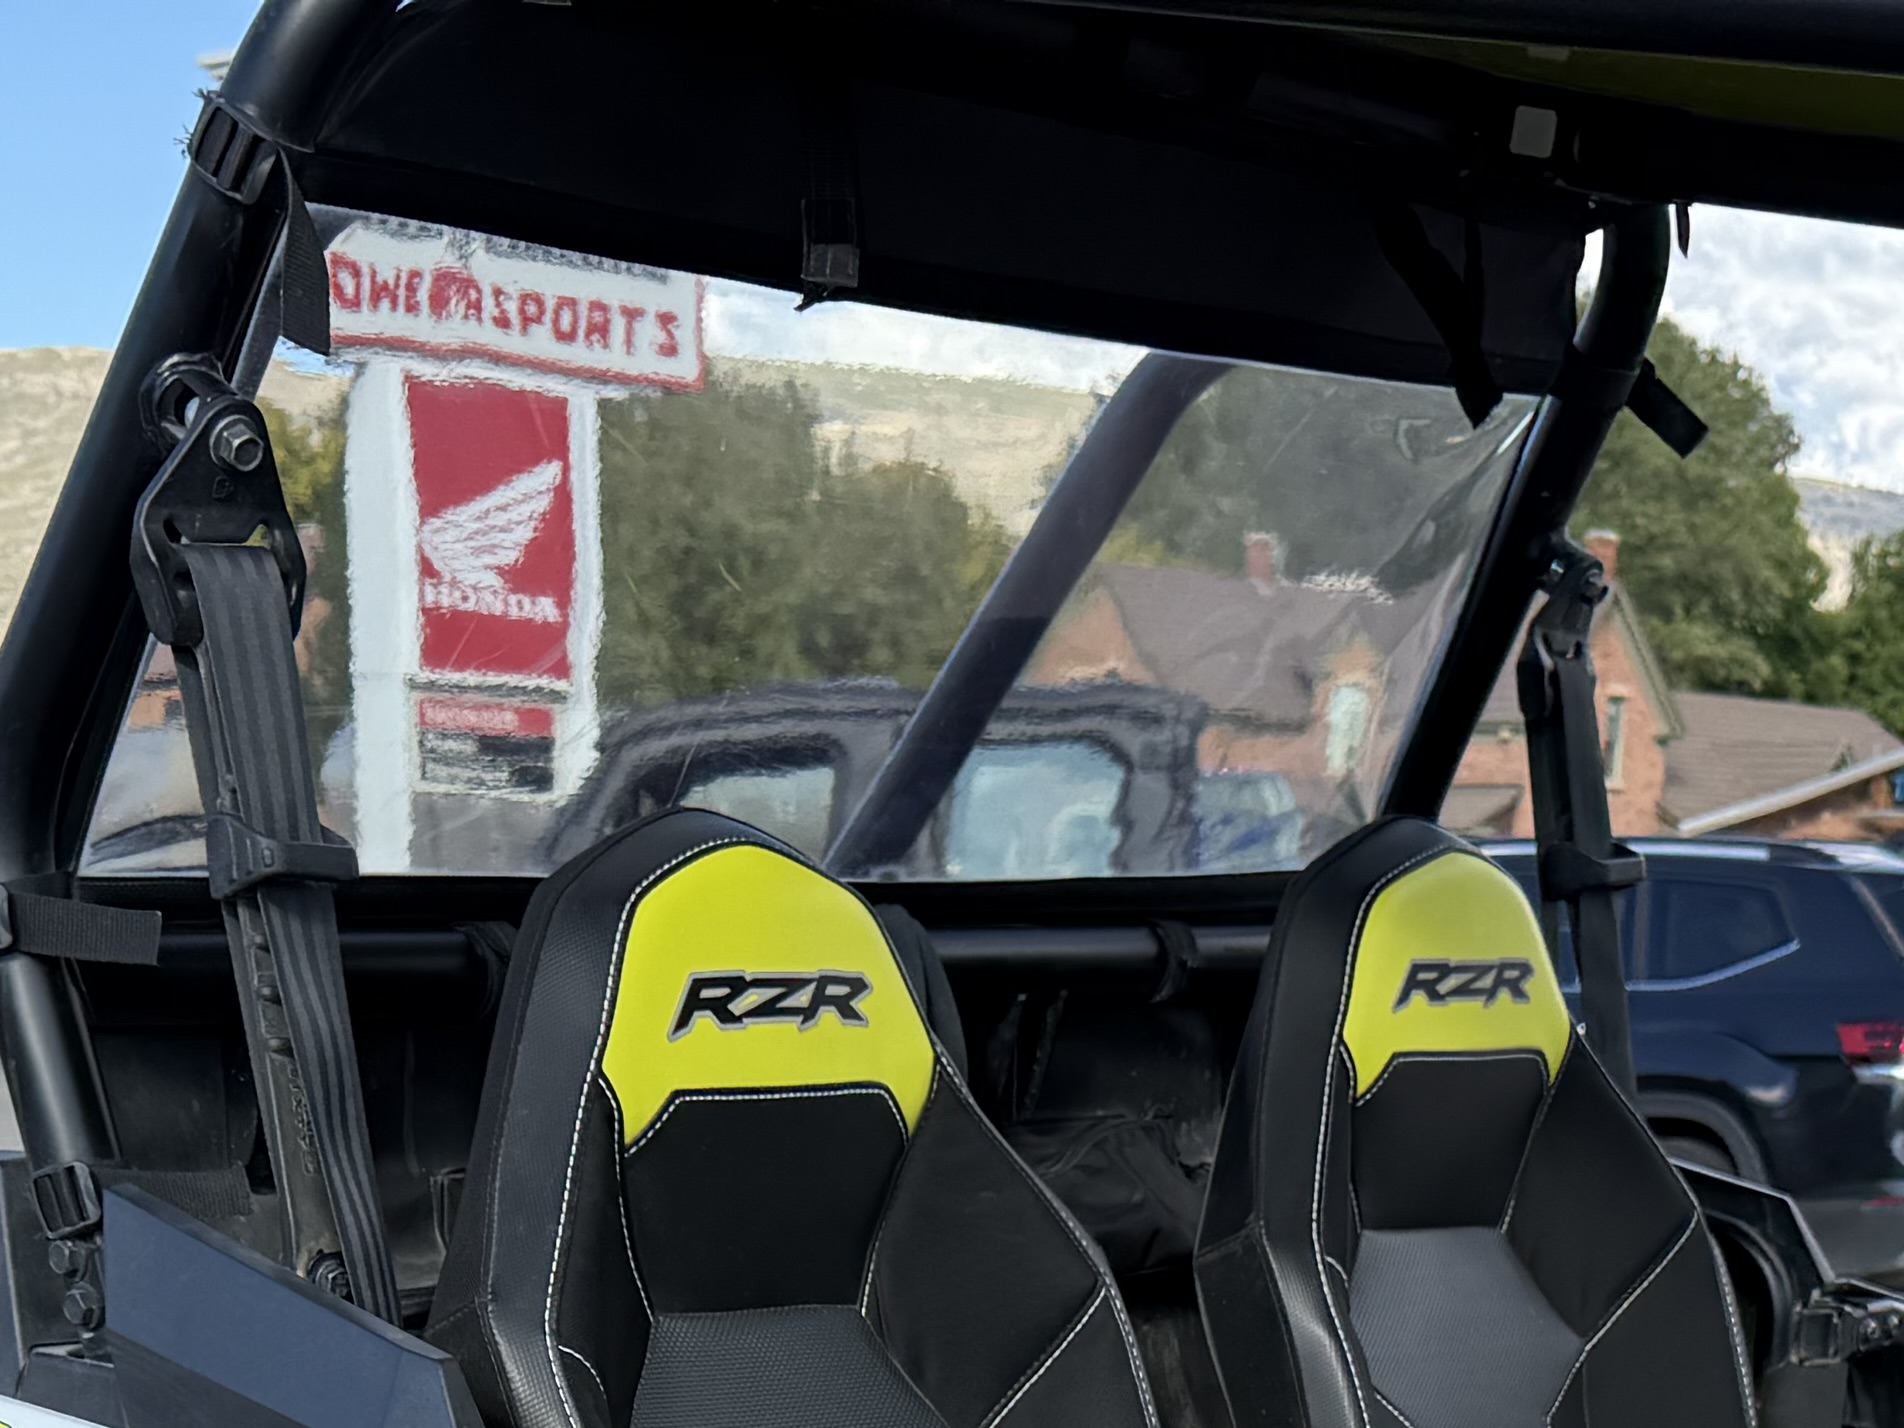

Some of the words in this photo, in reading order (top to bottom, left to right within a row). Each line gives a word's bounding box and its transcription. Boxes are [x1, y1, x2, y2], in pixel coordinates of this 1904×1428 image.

[422, 578, 563, 624] HONDA
[666, 969, 874, 1043] RZR
[1391, 957, 1535, 1014] RZR
